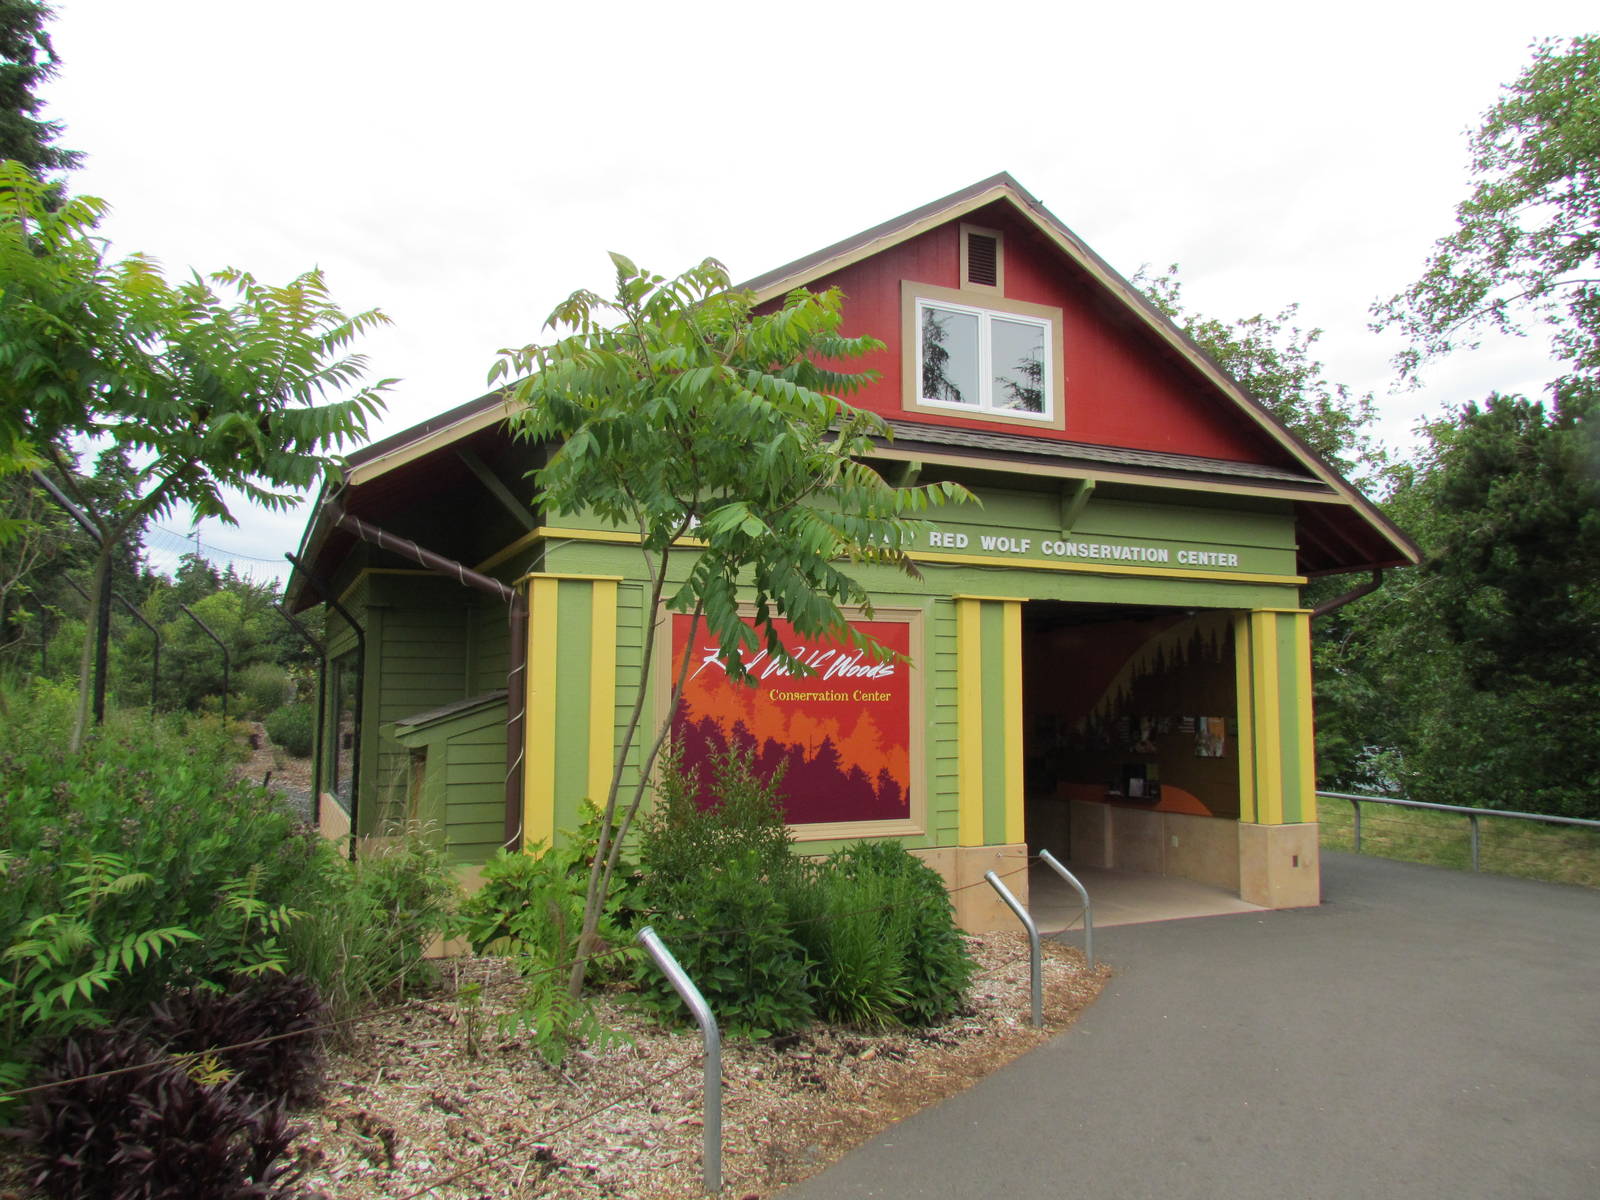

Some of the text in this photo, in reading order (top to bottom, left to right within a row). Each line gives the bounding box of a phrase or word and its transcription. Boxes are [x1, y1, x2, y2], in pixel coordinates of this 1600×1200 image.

[929, 531, 969, 549] RED
[980, 535, 1031, 553] WOLF
[1041, 540, 1169, 563] CONSERVATION
[1177, 550, 1239, 567] CENTER
[690, 646, 768, 681] Rd
[768, 688, 892, 702] Conservation Center
